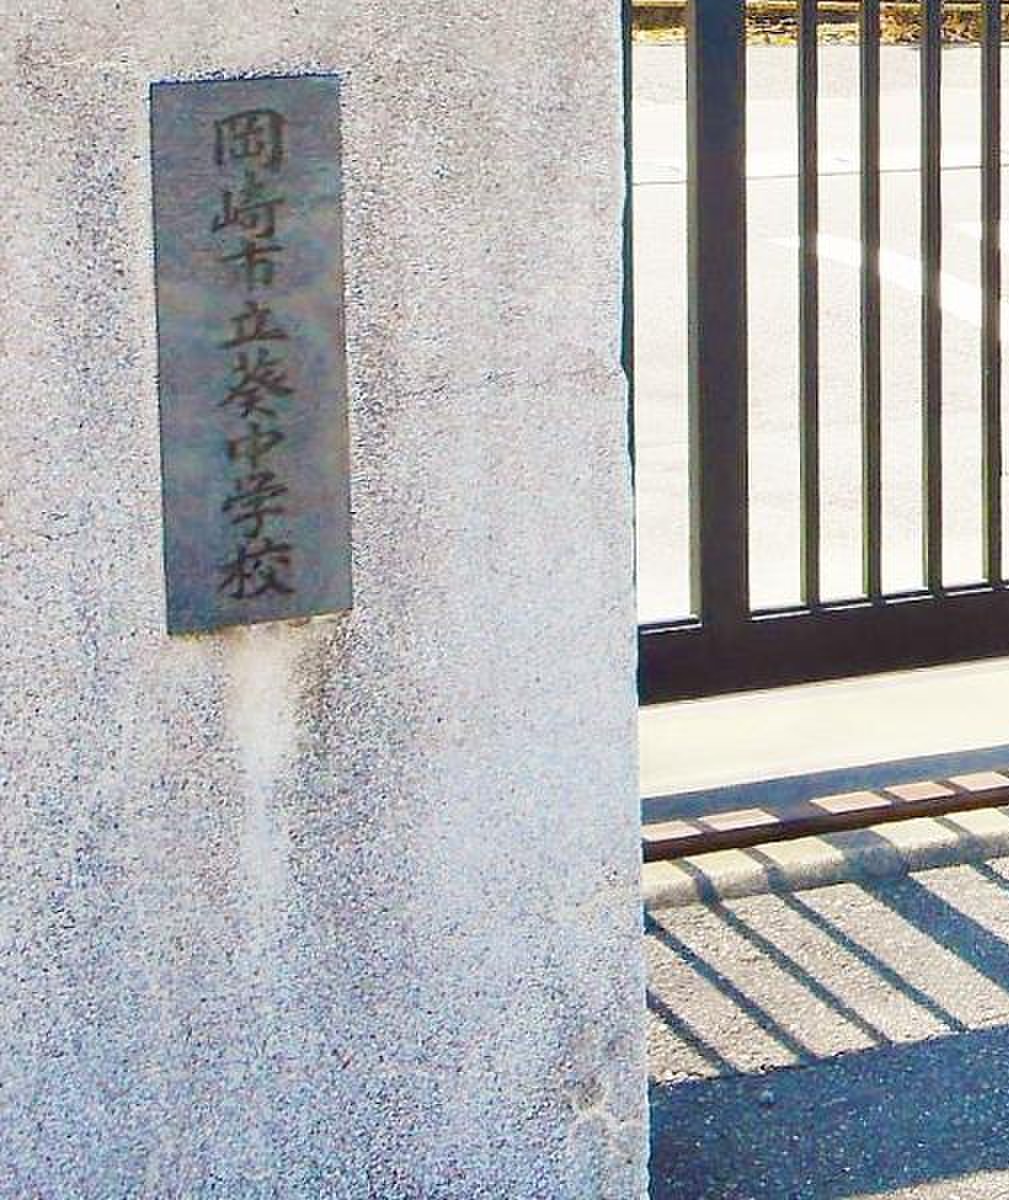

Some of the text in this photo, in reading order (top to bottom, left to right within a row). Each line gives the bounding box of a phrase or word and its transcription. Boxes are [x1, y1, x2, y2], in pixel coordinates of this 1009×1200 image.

[211, 107, 296, 601] 岡崎市立葵中学校
